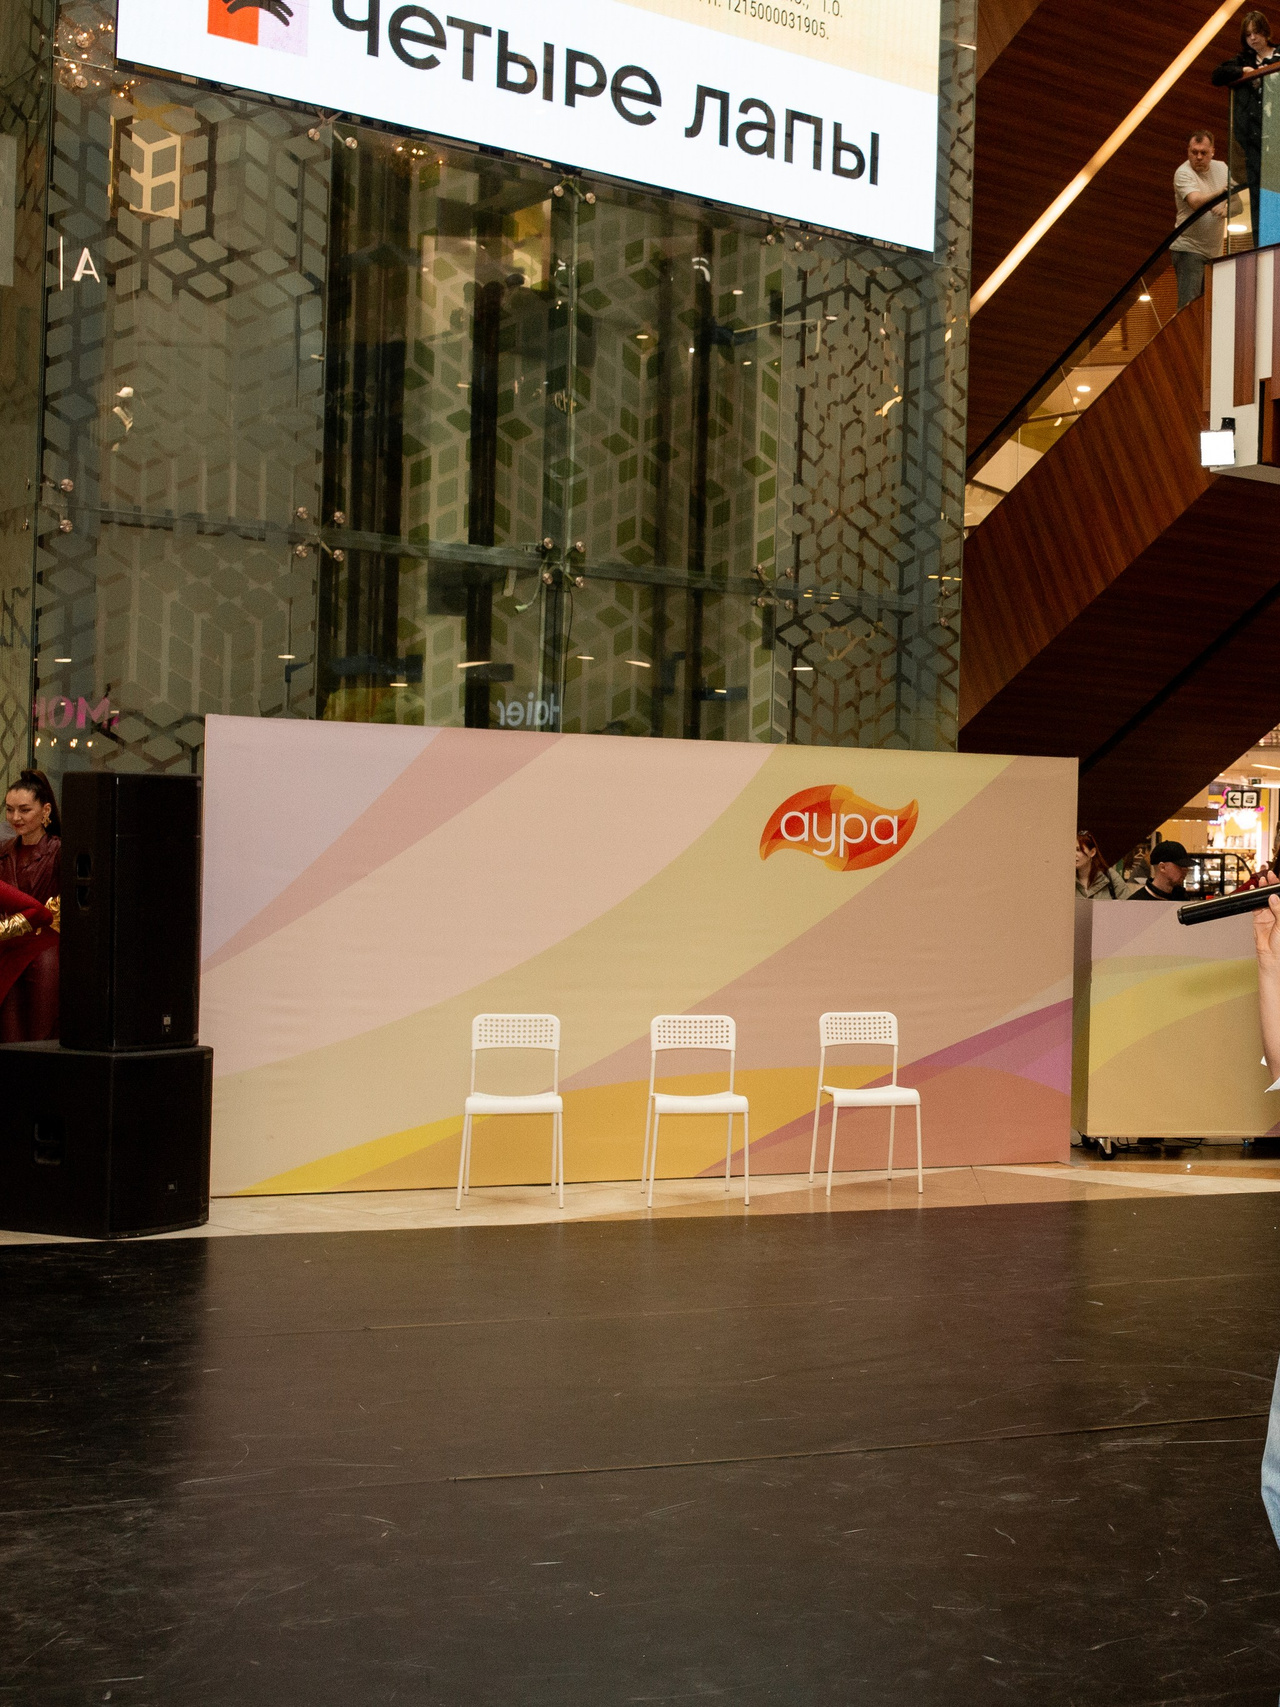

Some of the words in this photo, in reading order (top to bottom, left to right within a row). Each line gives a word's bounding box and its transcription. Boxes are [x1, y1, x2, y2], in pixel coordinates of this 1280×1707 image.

[331, 0, 662, 126] четыре
[684, 83, 880, 187] лапы
[780, 811, 898, 858] аура
